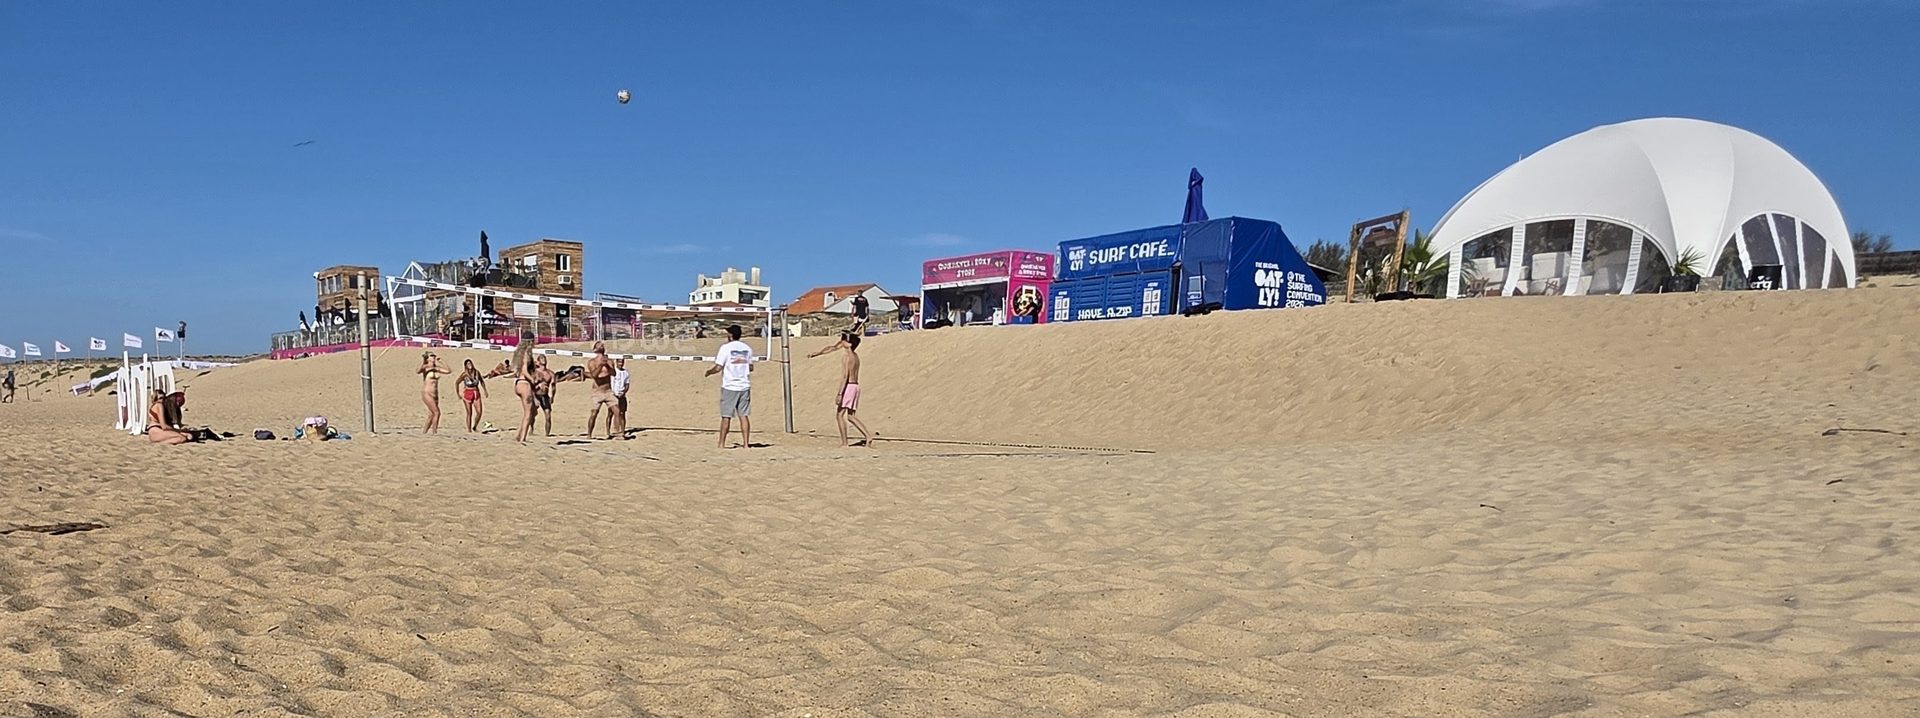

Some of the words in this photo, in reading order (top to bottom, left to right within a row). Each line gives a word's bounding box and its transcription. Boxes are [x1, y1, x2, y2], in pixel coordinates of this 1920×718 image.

[1089, 246, 1128, 264] SURF
[975, 258, 991, 266] ROXY
[1070, 260, 1083, 271] LY!
[957, 269, 975, 277] STORE
[1255, 269, 1284, 288] OAT-
[1295, 273, 1306, 282] THE
[1287, 282, 1313, 292] SURFING
[1258, 288, 1280, 306] LY!
[1287, 291, 1322, 303] CONVENTION
